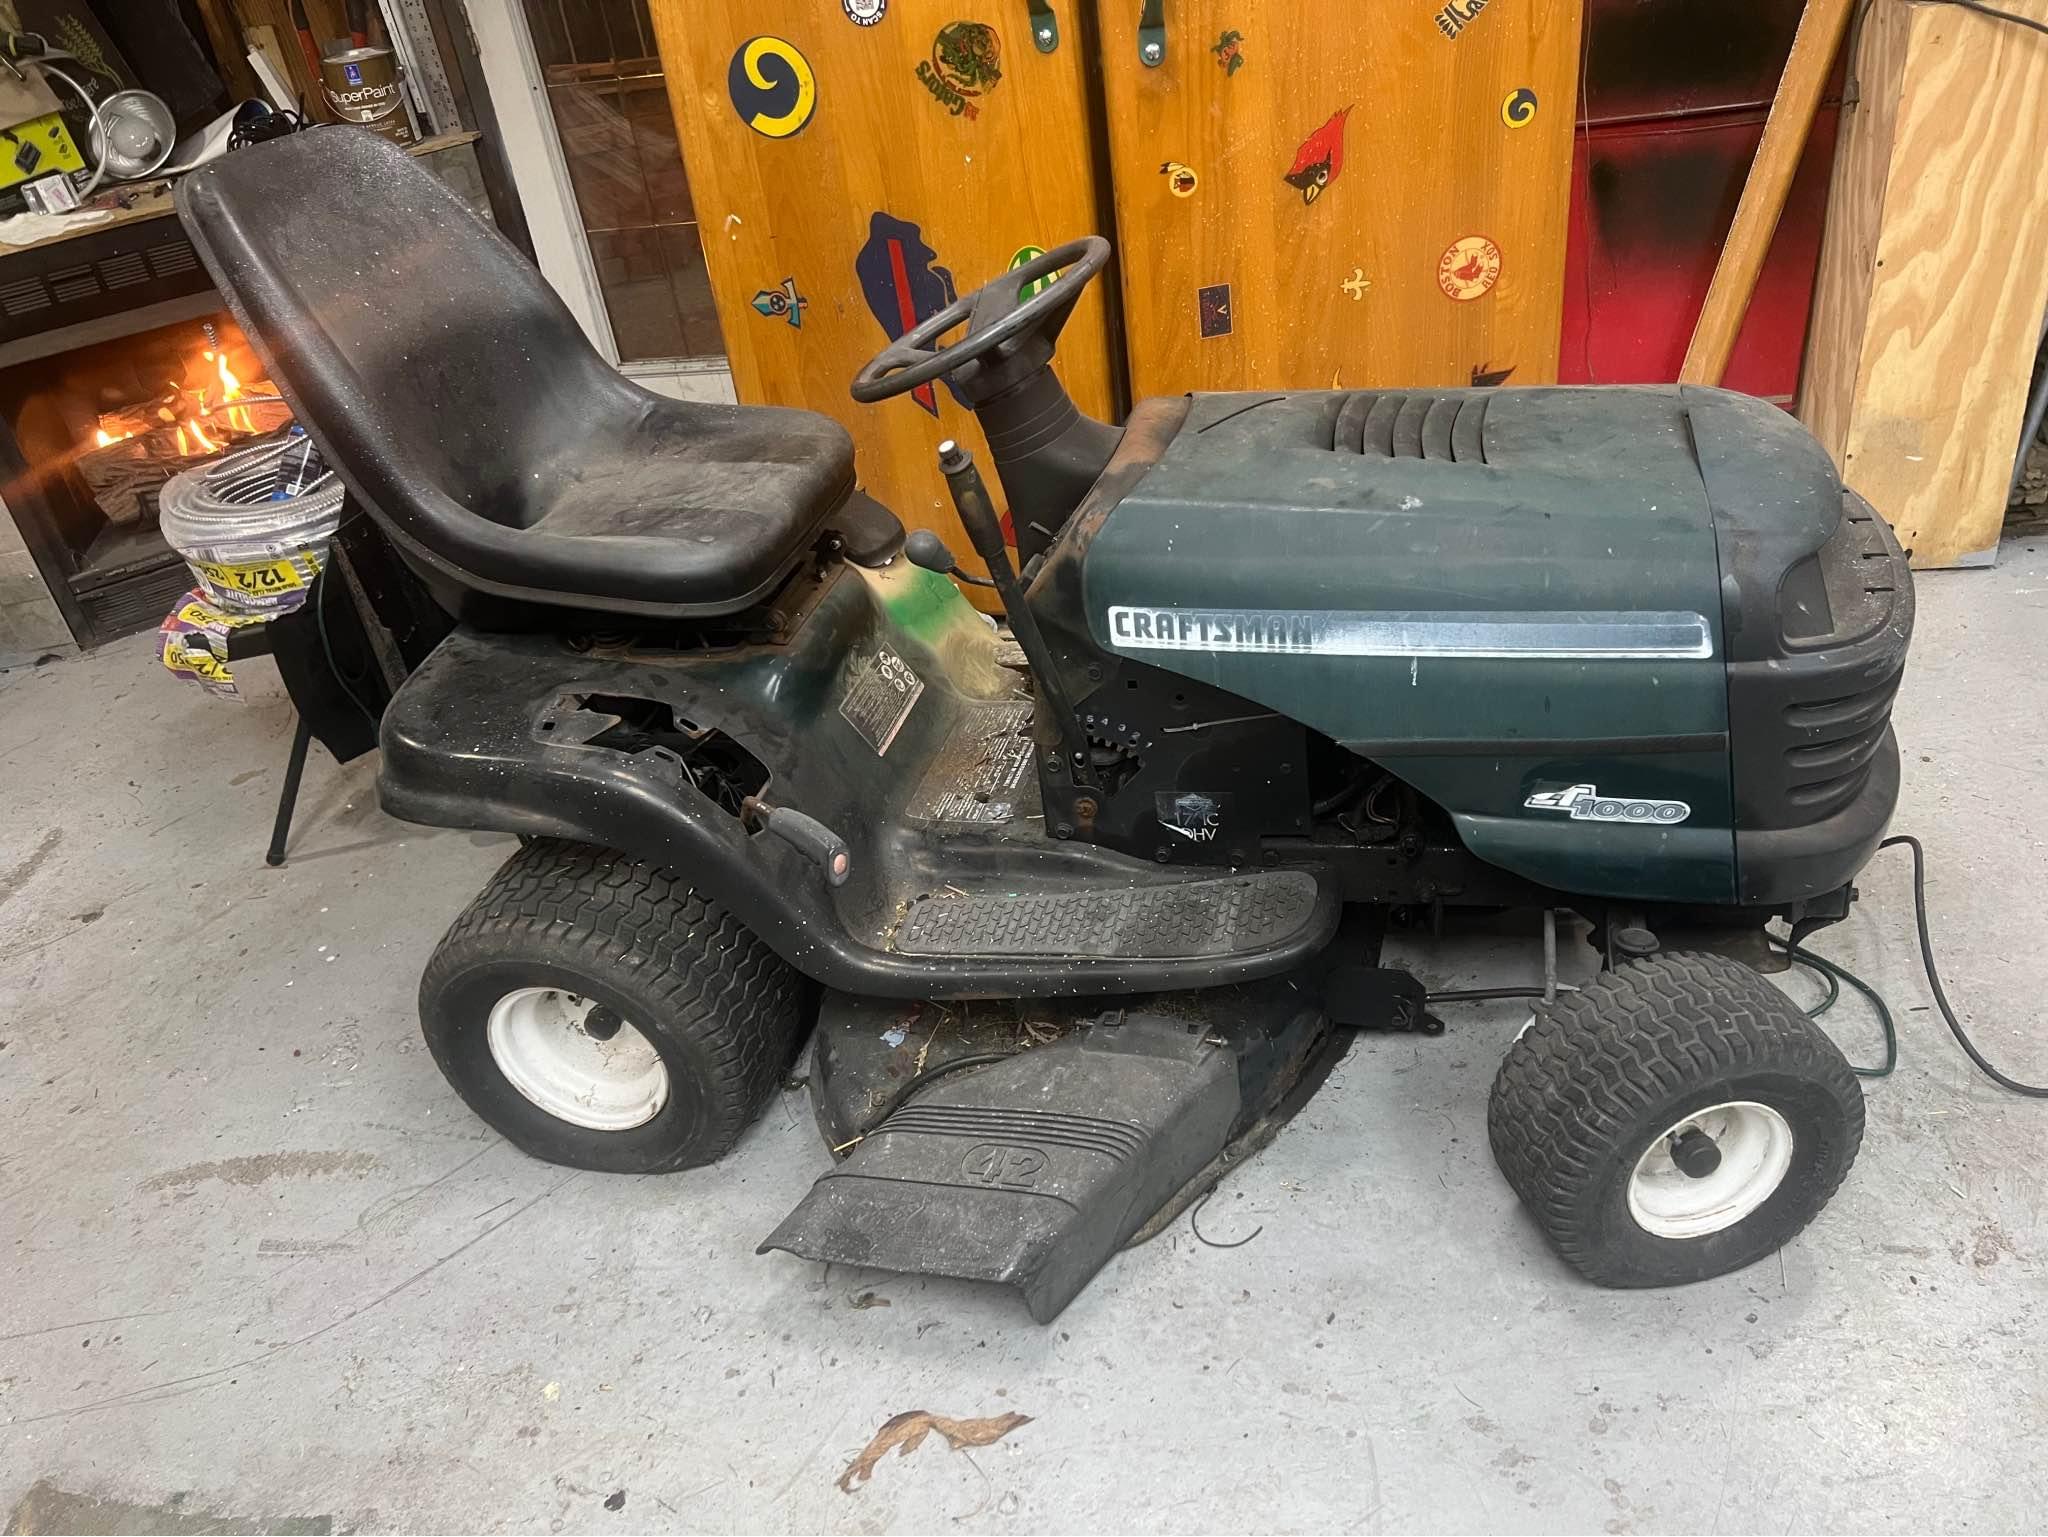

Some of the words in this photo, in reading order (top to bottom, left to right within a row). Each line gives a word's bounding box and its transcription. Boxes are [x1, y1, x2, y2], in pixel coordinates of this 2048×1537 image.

[850, 13, 861, 25] TO
[862, 11, 883, 26] SCAN
[329, 84, 396, 105] SuperPaint
[1480, 241, 1498, 261] SOX
[1440, 245, 1463, 298] BOSTON
[1481, 266, 1498, 289] RED
[235, 570, 286, 589] 12/2
[1114, 609, 1313, 646] CRAFTSMAN
[1086, 714, 1094, 723] 5
[1118, 723, 1127, 732] 3
[967, 1147, 1045, 1188] 42
